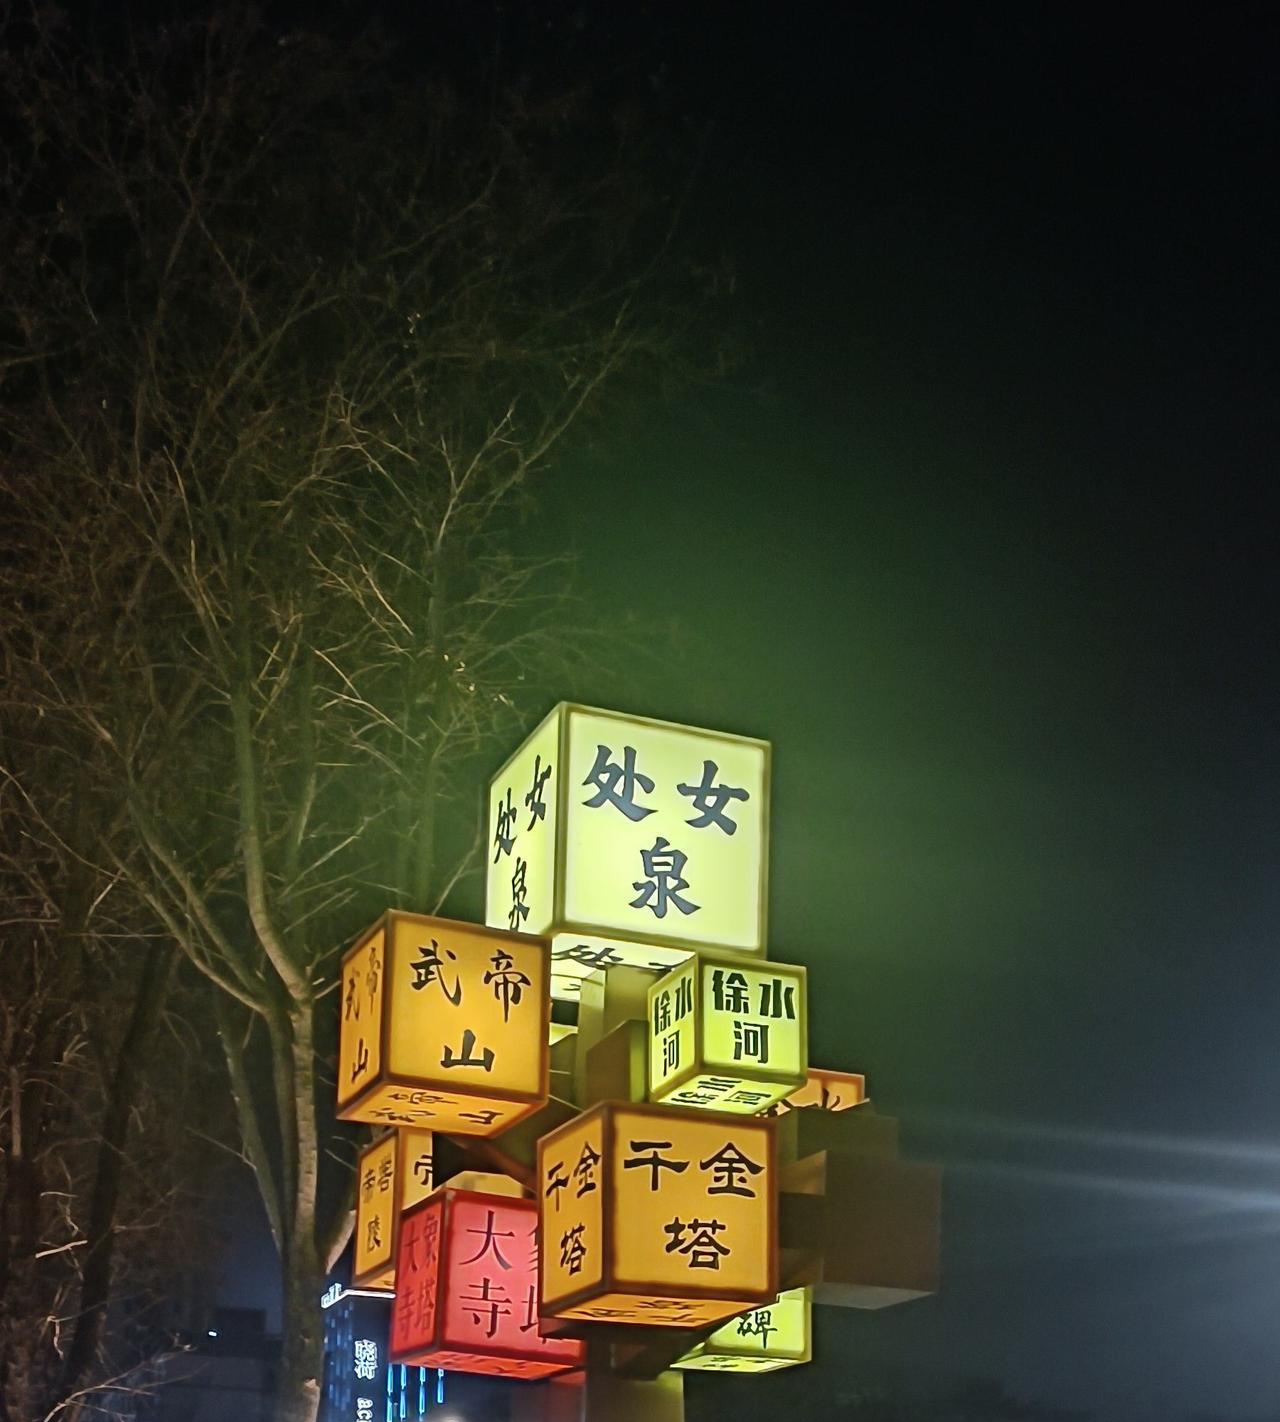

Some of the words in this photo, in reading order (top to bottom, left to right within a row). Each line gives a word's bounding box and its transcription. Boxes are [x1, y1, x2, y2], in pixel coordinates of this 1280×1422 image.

[582, 744, 750, 836] 处女
[629, 836, 702, 919] 泉
[410, 939, 531, 1024] 武帝
[654, 976, 693, 1037] 徐水
[712, 969, 796, 1020] 徐水
[440, 1029, 495, 1073] 山
[663, 1029, 680, 1077] 河
[733, 1020, 769, 1064] 河
[458, 1210, 538, 1273] 大
[560, 1222, 587, 1276] 塔
[664, 1217, 730, 1270] 塔
[737, 1310, 778, 1350] 碑
